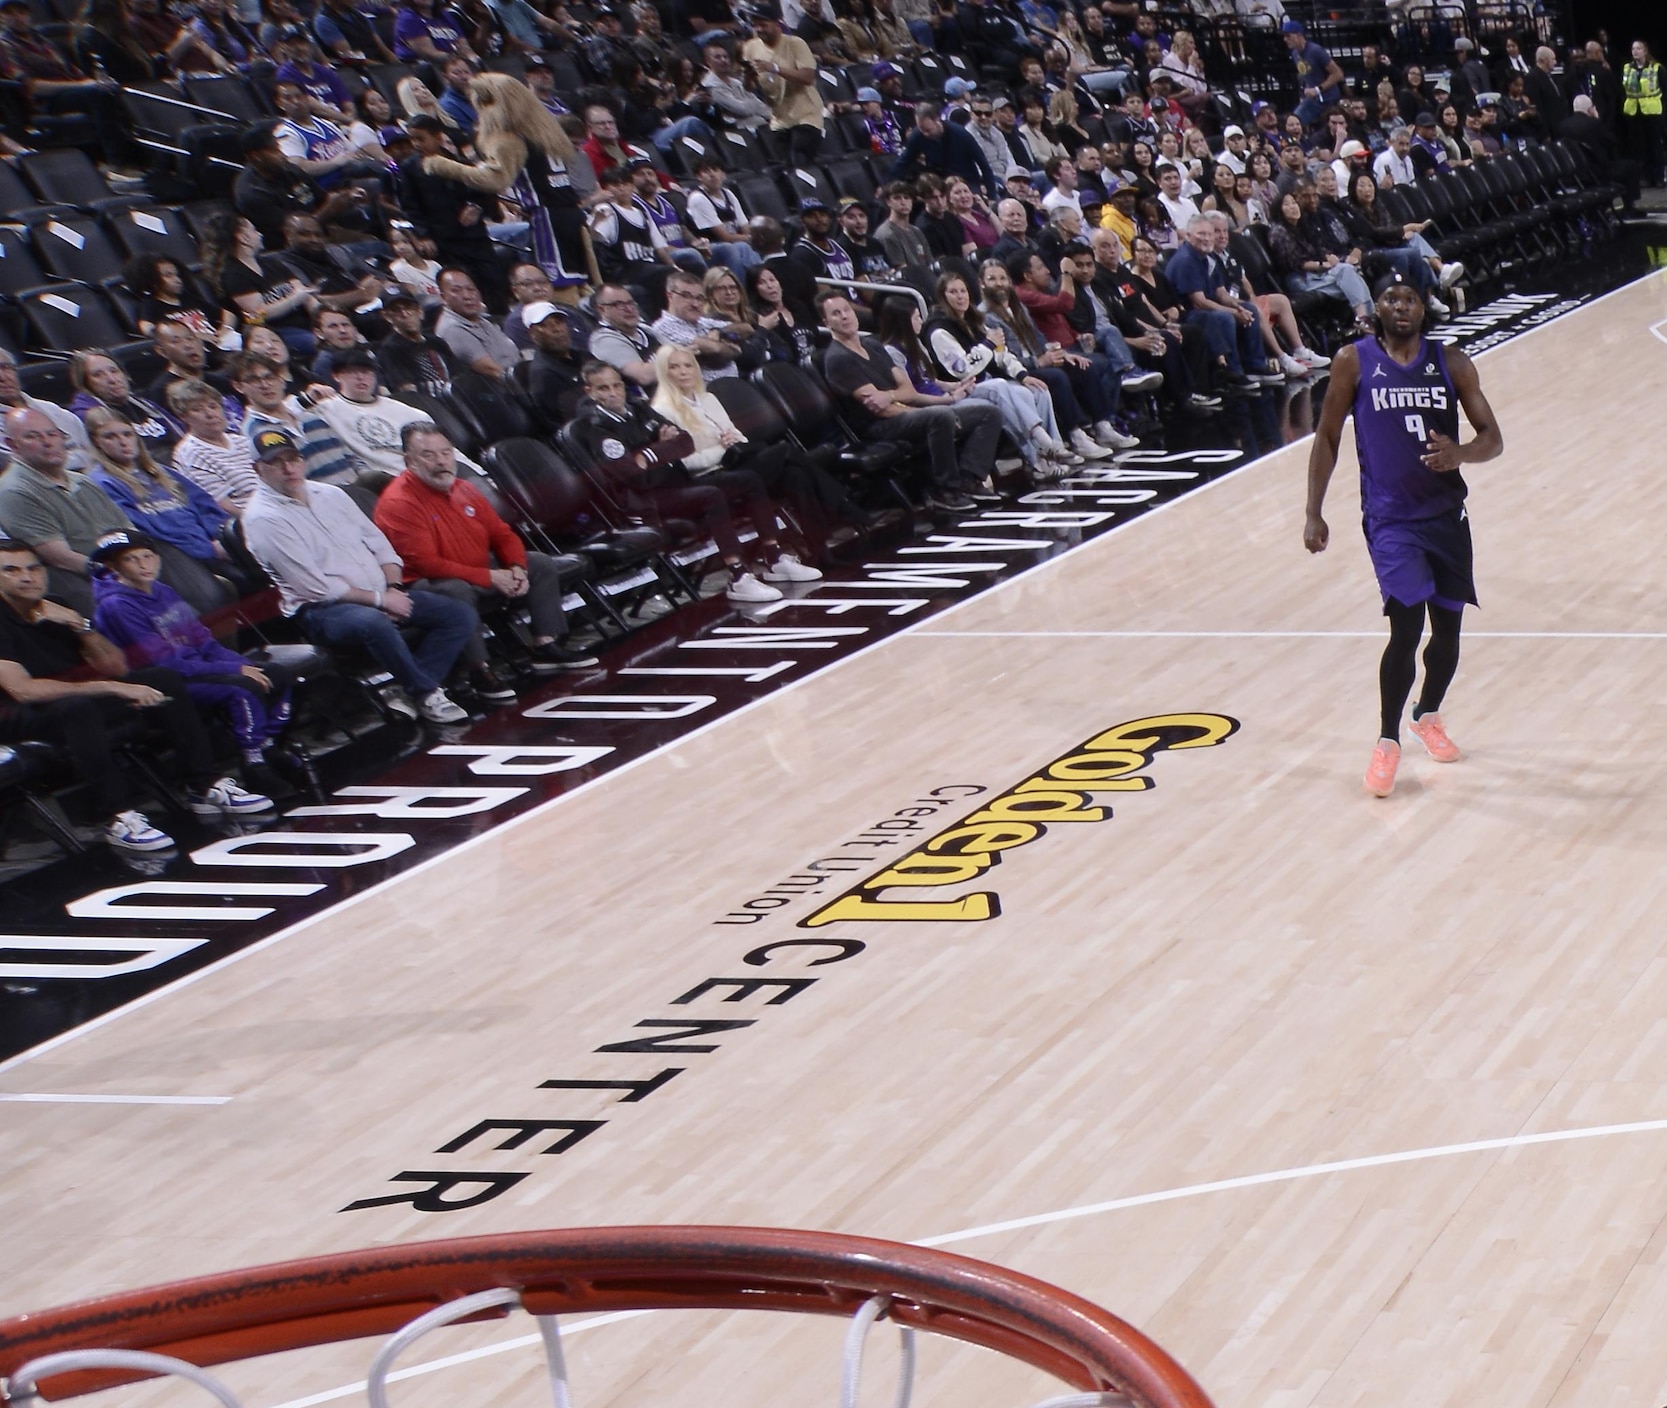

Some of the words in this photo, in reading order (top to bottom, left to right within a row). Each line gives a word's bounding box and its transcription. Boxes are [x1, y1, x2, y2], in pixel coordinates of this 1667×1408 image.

[1405, 415, 1427, 441] 9
[522, 448, 1244, 721] SACRAMENTO
[0, 744, 617, 979] PROUD
[712, 855, 878, 928] Union
[840, 783, 988, 849] Credit
[337, 937, 867, 1213] CENTER
